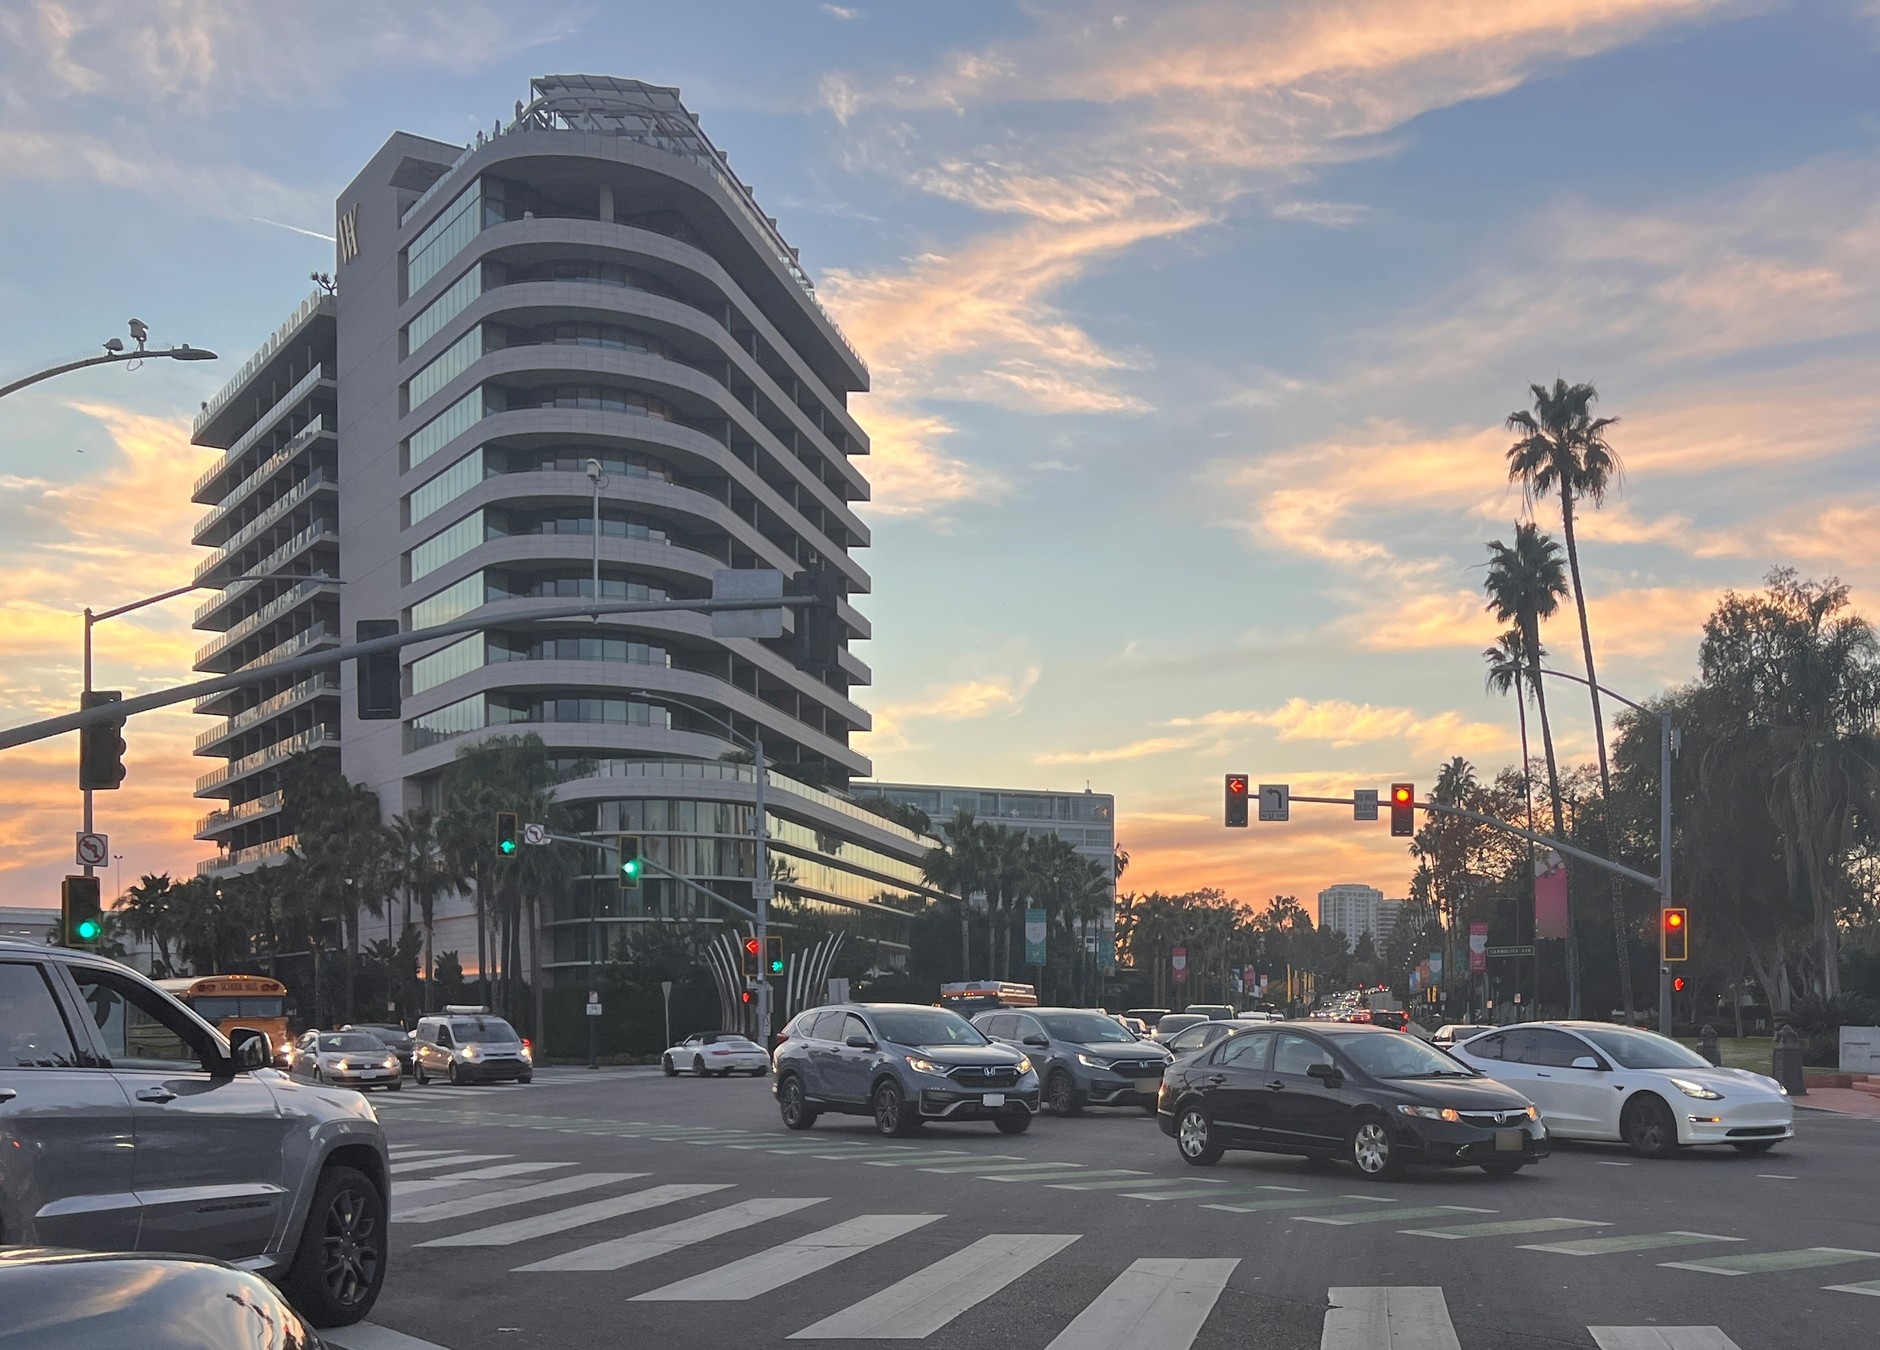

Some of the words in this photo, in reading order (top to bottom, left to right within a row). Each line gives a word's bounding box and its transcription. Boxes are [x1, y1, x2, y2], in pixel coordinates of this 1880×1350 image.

[1365, 793, 1376, 801] NOT
[1356, 803, 1376, 811] BLOCK
[220, 982, 243, 991] SCHOOL
[246, 982, 258, 991] BUS
